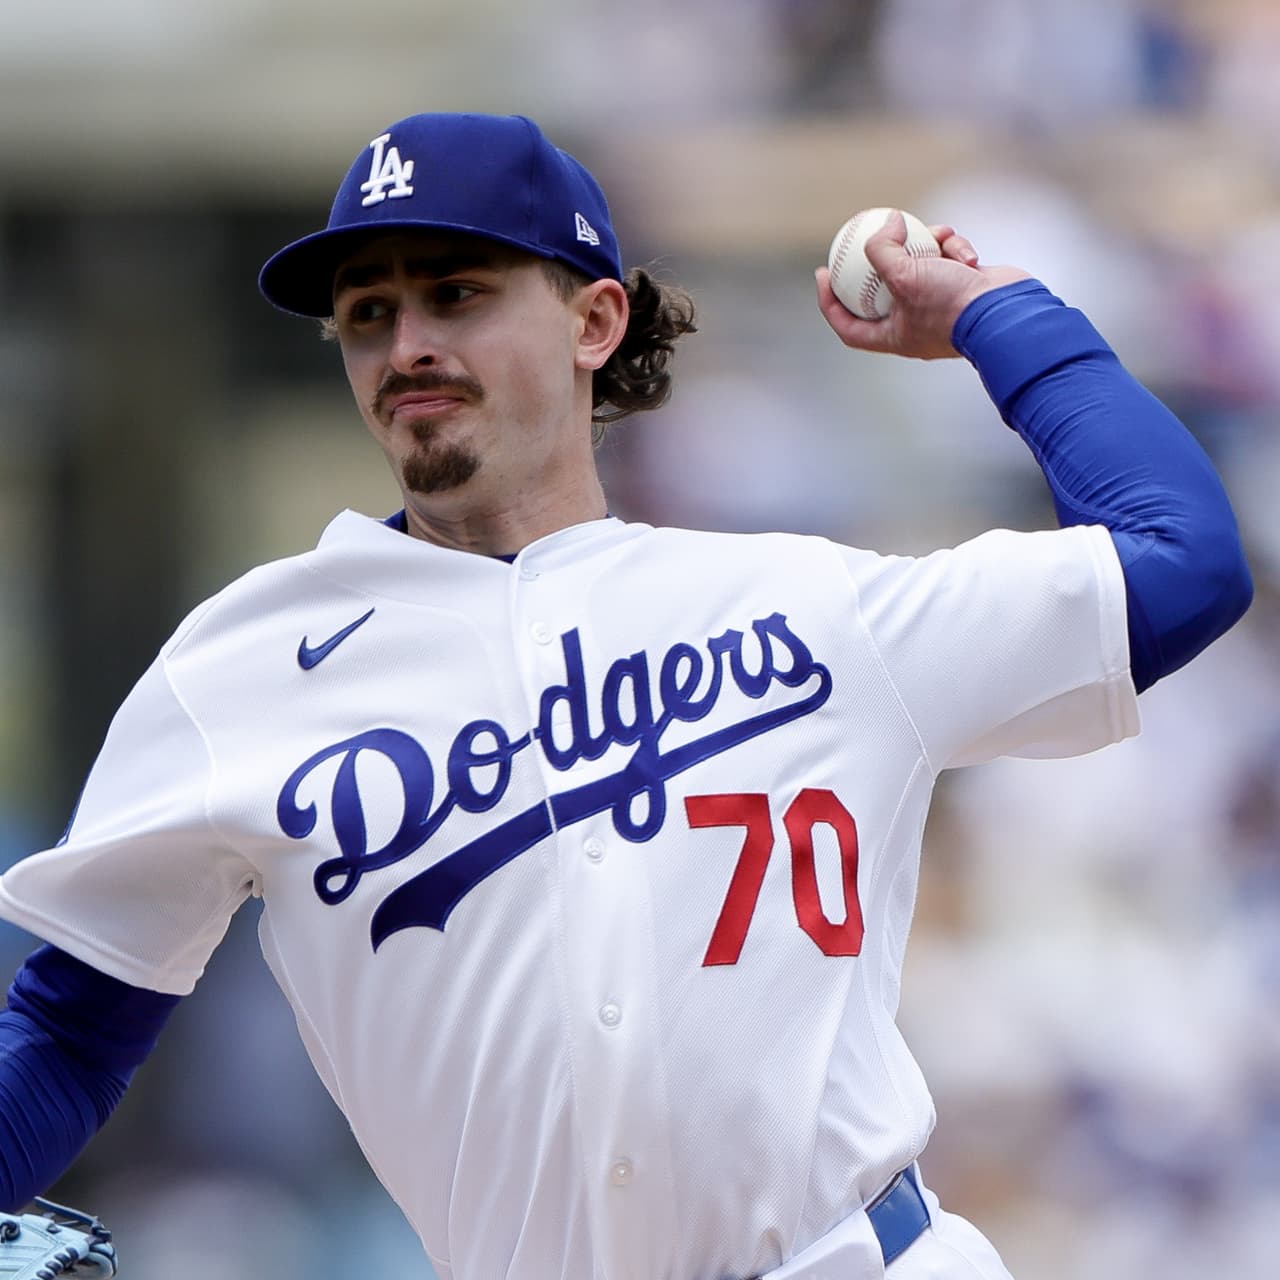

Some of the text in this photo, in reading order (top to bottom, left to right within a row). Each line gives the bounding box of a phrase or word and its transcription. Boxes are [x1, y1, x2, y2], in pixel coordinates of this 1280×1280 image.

[360, 133, 414, 207] LA
[277, 612, 832, 953] Dodgers
[684, 788, 865, 967] 70
